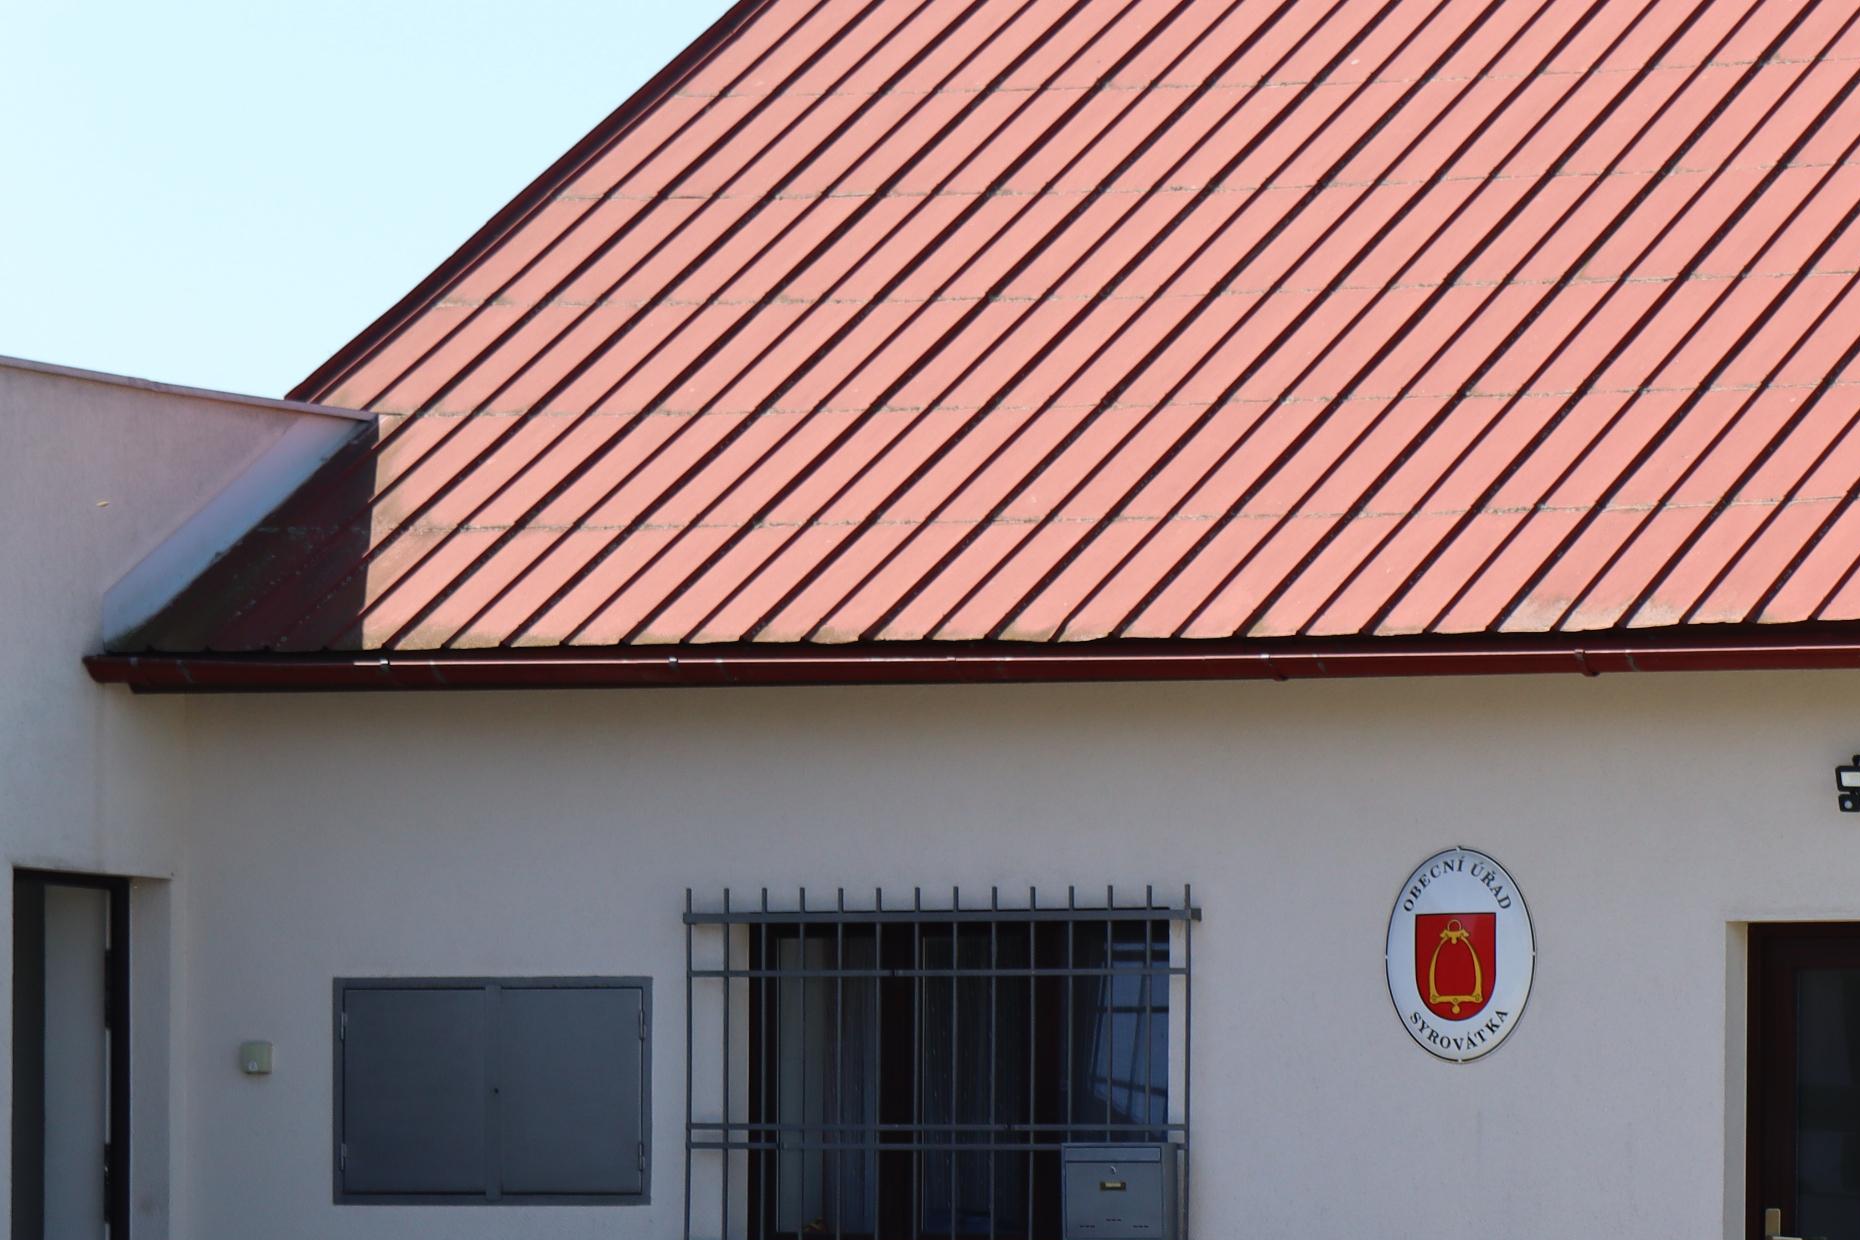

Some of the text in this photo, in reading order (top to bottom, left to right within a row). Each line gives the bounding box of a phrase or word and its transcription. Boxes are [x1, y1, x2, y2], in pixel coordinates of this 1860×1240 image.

[1403, 857, 1512, 912] OBECNÍ ÚŘAD
[1410, 1009, 1508, 1051] SYROVÁTKA
